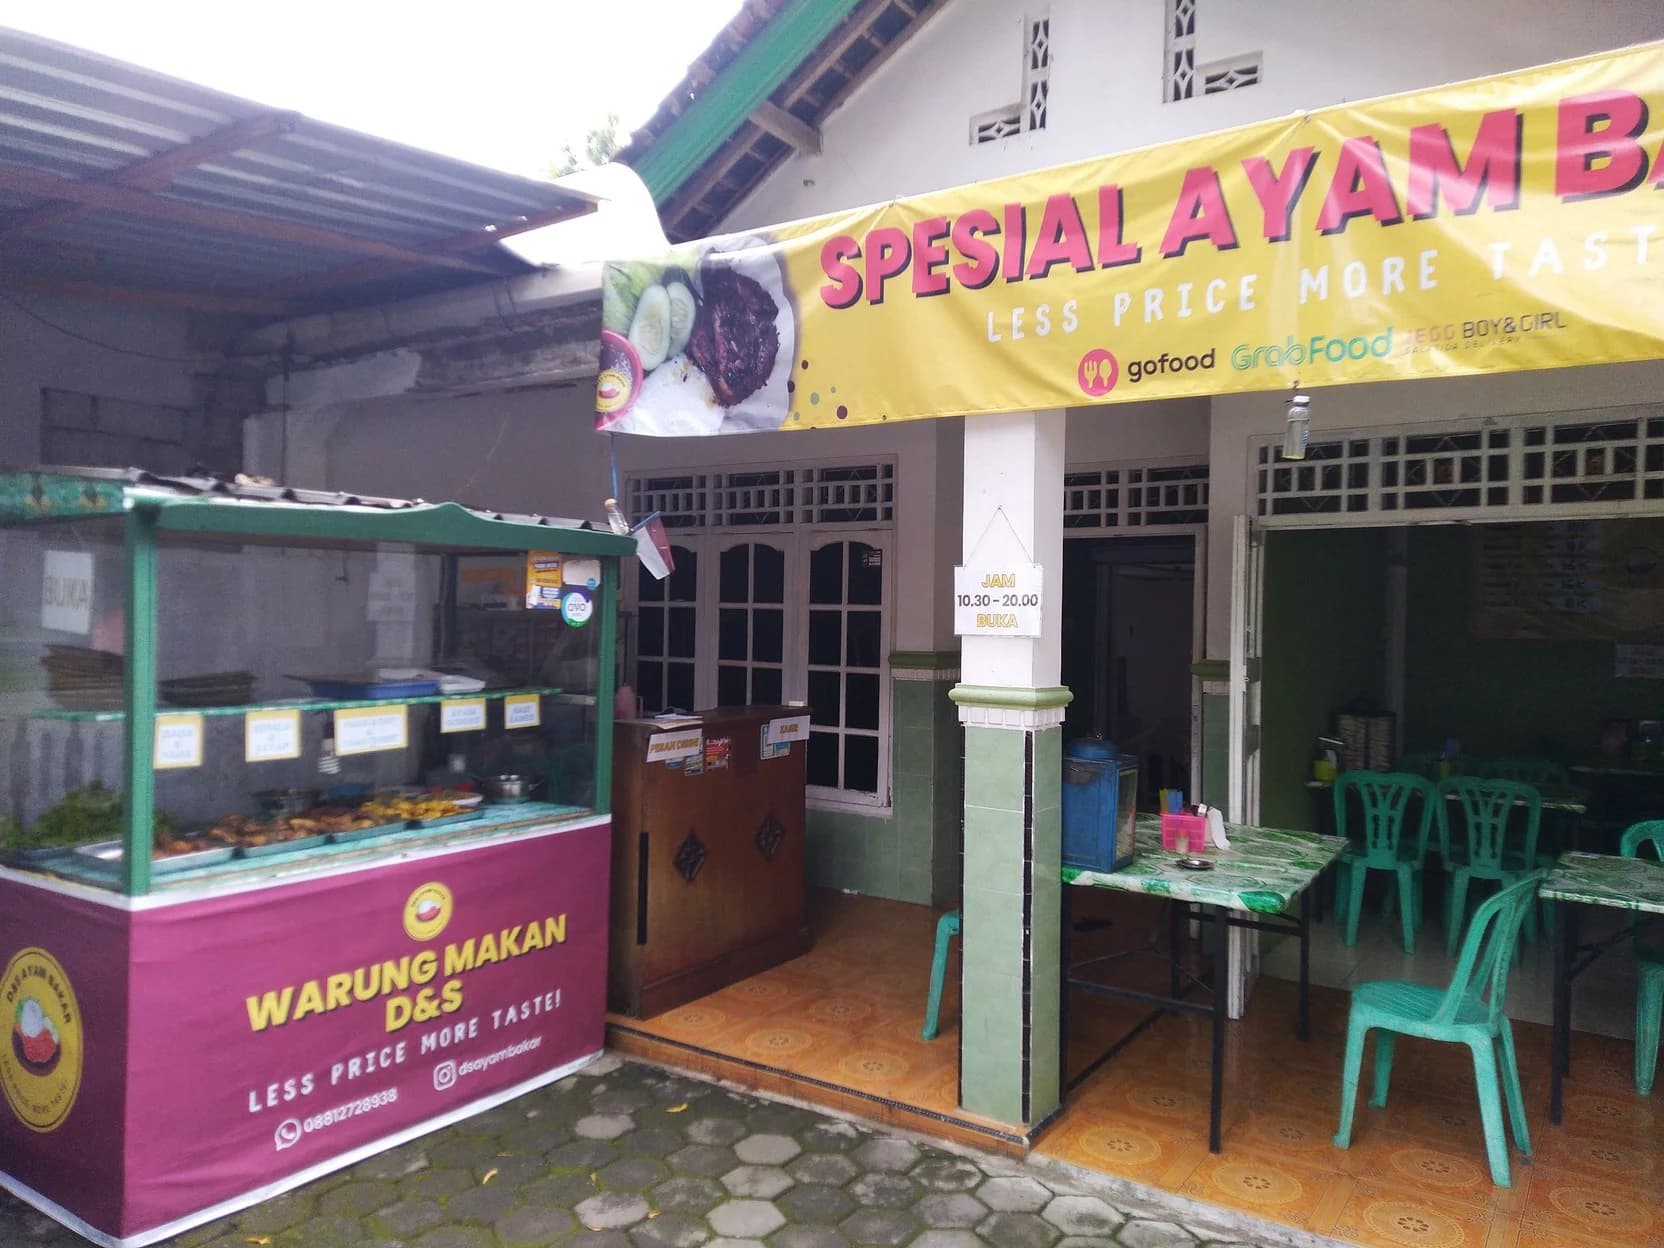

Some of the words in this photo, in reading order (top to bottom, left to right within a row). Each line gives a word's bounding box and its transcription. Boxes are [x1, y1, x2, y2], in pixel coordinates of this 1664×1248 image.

[820, 184, 1142, 309] SPESIAL
[1159, 108, 1523, 259] AYAM
[1555, 89, 1664, 204] B
[987, 299, 1079, 343] LESS
[1113, 274, 1257, 327] PRICE
[1300, 250, 1438, 305] MORE
[1488, 224, 1656, 280] TAST
[1128, 348, 1216, 383] gofood
[1231, 326, 1393, 372] GrabFood
[957, 594, 991, 607] 10.30
[1002, 594, 1039, 607] 20.00
[981, 573, 1016, 588] JAM
[976, 613, 1018, 628] BUKA
[246, 950, 438, 1032] WARUNG
[443, 914, 567, 977] MAKAN
[385, 979, 464, 1032] D&S
[248, 1072, 315, 1113] LESS
[331, 1041, 407, 1085] PRICE
[421, 1016, 479, 1055] MORE
[491, 988, 562, 1031] TASTE!
[458, 1036, 543, 1076] dsayambakar
